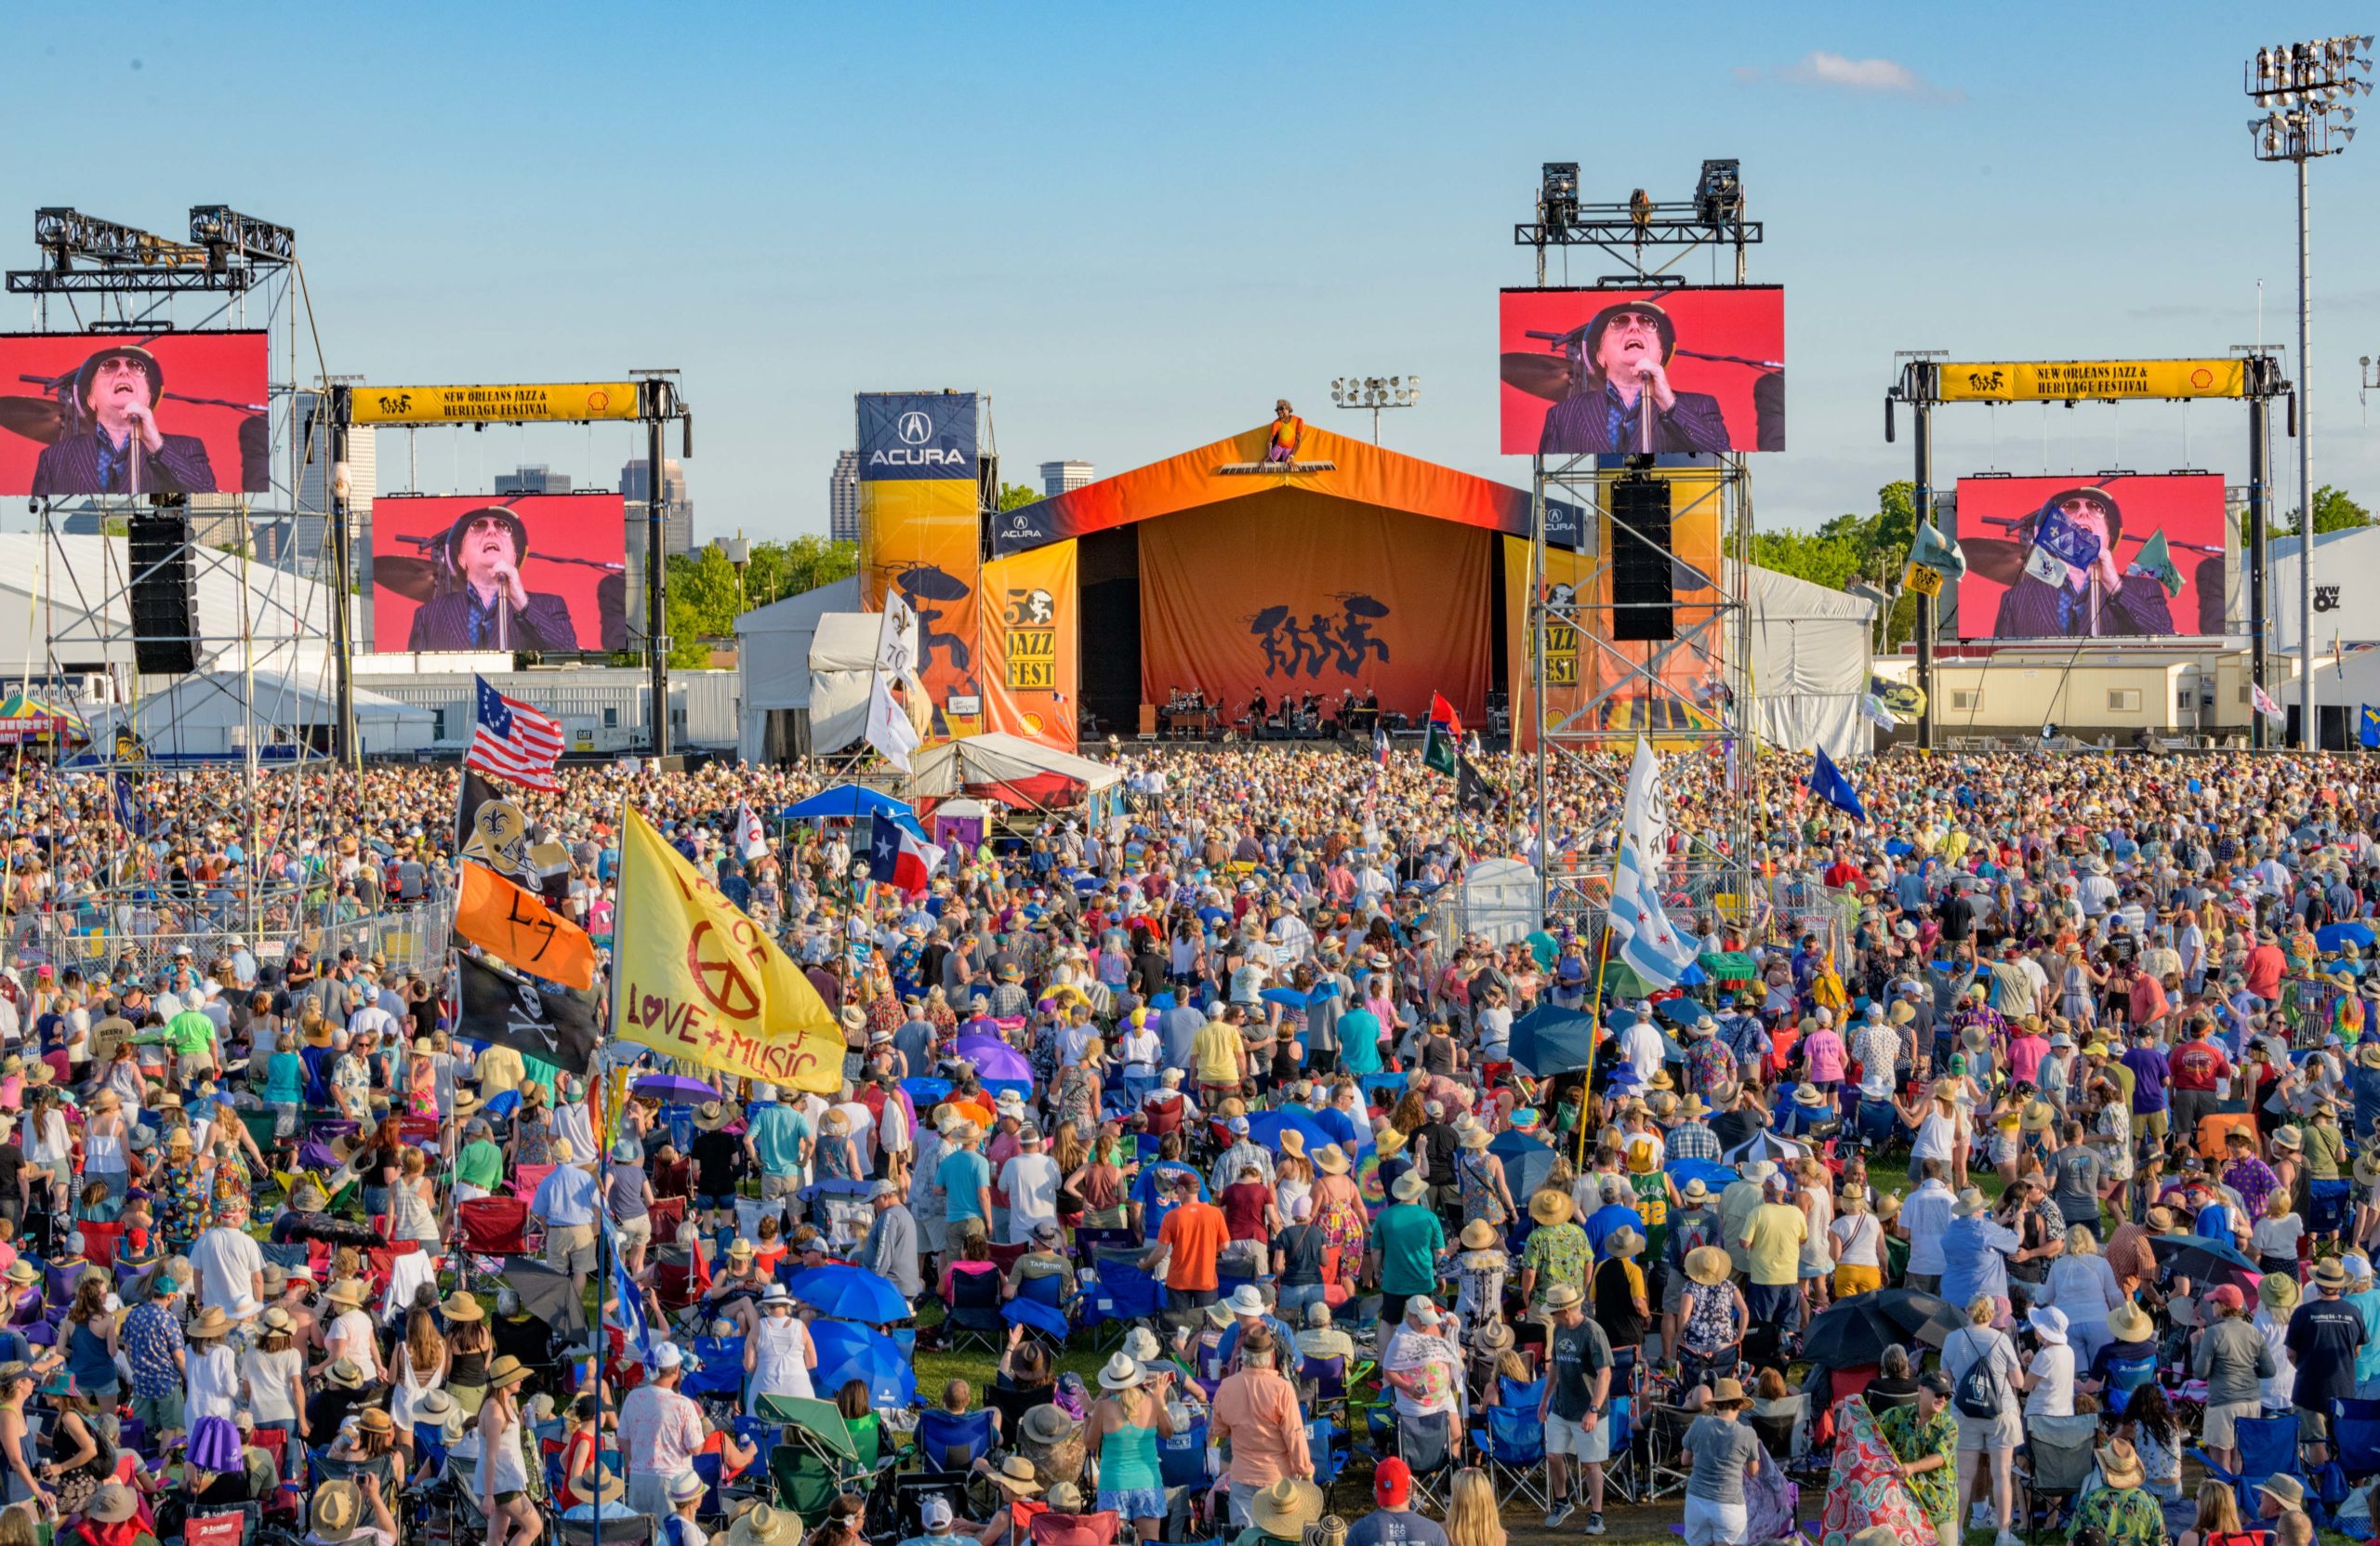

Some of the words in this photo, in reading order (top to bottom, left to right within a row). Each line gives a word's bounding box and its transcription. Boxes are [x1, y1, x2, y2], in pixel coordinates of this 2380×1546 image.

[2038, 368, 2060, 379] NEW
[2063, 367, 2110, 379] ORLEANS
[2112, 366, 2135, 378] JAZZ
[2139, 367, 2148, 377] &
[2038, 381, 2095, 394] HERITAGE
[2097, 380, 2149, 392] FESTIVAL
[444, 392, 465, 403] NEW
[468, 391, 512, 402] ORLEANS
[514, 390, 537, 402] JAZZ
[539, 391, 547, 401] &
[444, 404, 497, 416] HERITAGE
[500, 403, 549, 416] FESTIVAL
[868, 448, 966, 465] ACURA
[1001, 529, 1042, 538] ACURA
[1543, 522, 1577, 532] CURA
[1003, 588, 1054, 626] 50
[1007, 632, 1053, 659] JAZZ
[1007, 662, 1054, 685] FEST
[725, 1028, 817, 1079] MUSIC
[1635, 1200, 1667, 1225] 32
[209, 1523, 232, 1532] Academy
